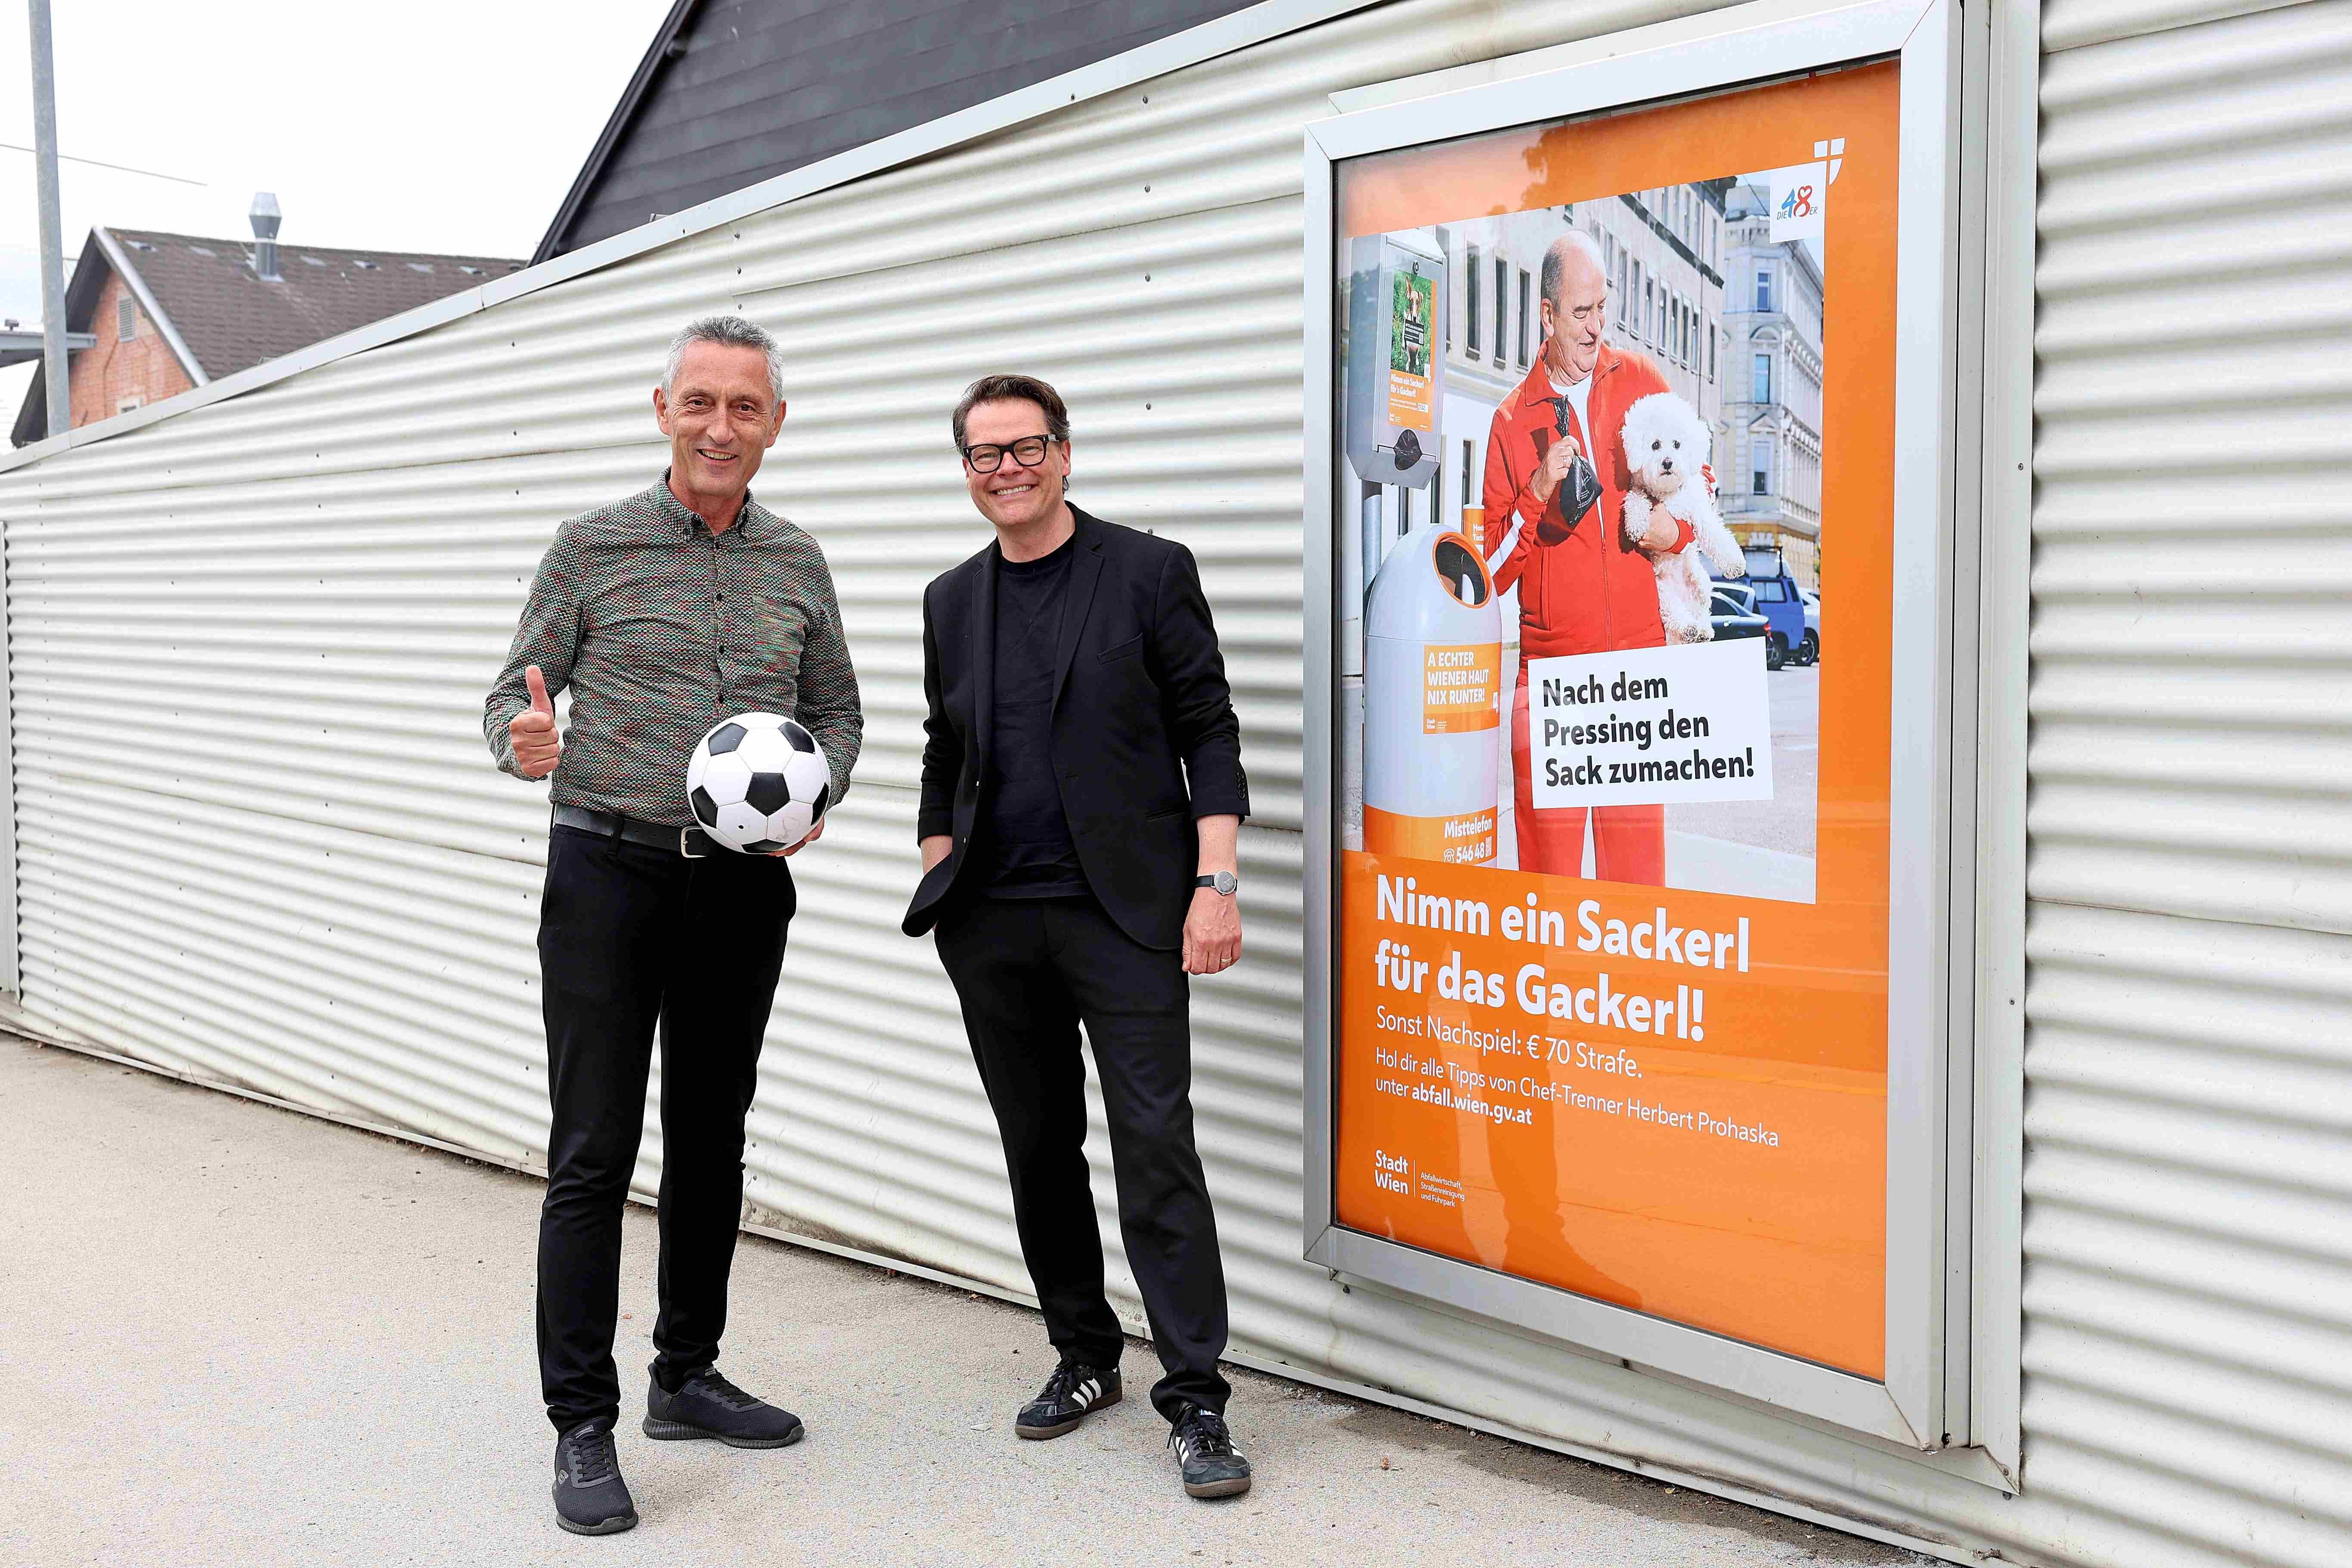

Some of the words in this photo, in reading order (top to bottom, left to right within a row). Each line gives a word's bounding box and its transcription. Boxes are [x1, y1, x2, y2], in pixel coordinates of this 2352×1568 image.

[1777, 211, 1788, 220] DIE
[1391, 373, 1403, 384] Nimm
[1427, 652, 1436, 667] A
[1438, 651, 1474, 666] ECHTER
[1427, 670, 1467, 686] WIENER
[1469, 668, 1489, 685] HAUT
[1543, 674, 1604, 707] Nach
[1611, 671, 1668, 701] dem
[1427, 690, 1447, 705] NIX
[1449, 688, 1485, 704] RUNTER!
[1544, 713, 1651, 750] Pressing
[1658, 709, 1709, 739] den
[1546, 756, 1603, 786] Sack
[1608, 747, 1754, 783] zumachen!
[1444, 815, 1492, 839] Misttelefon
[1456, 845, 1473, 863] 546
[1474, 842, 1484, 859] 48
[1377, 874, 1490, 936] Nimm
[1501, 892, 1565, 947] ein
[1577, 899, 1749, 973] Sackerl
[1375, 939, 1429, 994] für
[1437, 951, 1505, 1008] das
[1515, 964, 1704, 1042] Gackerl!
[1376, 1005, 1422, 1037] Sonst
[1427, 1014, 1522, 1057] Nachspiel:
[1526, 1034, 1540, 1060] €
[1545, 1037, 1571, 1064] 70
[1575, 1042, 1643, 1078] Strafe.
[1376, 1047, 1397, 1068] Hol
[1400, 1053, 1417, 1072] dir
[1421, 1057, 1444, 1078] alle
[1447, 1062, 1485, 1090] Tipps
[1488, 1075, 1516, 1094] von
[1520, 1077, 1623, 1115] Chef-Trenner
[1627, 1097, 1694, 1130] Herbert
[1698, 1112, 1780, 1147] Prohaska
[1376, 1078, 1409, 1097] unter
[1411, 1082, 1532, 1125] abfall.wien.gv.at
[1375, 1149, 1408, 1174] Stadt
[1375, 1169, 1408, 1194] Wien
[1421, 1172, 1463, 1191] Abfallwirtschaft,
[1421, 1182, 1465, 1202] Straßenreinigung
[1432, 1194, 1456, 1207] Fuhrpark
